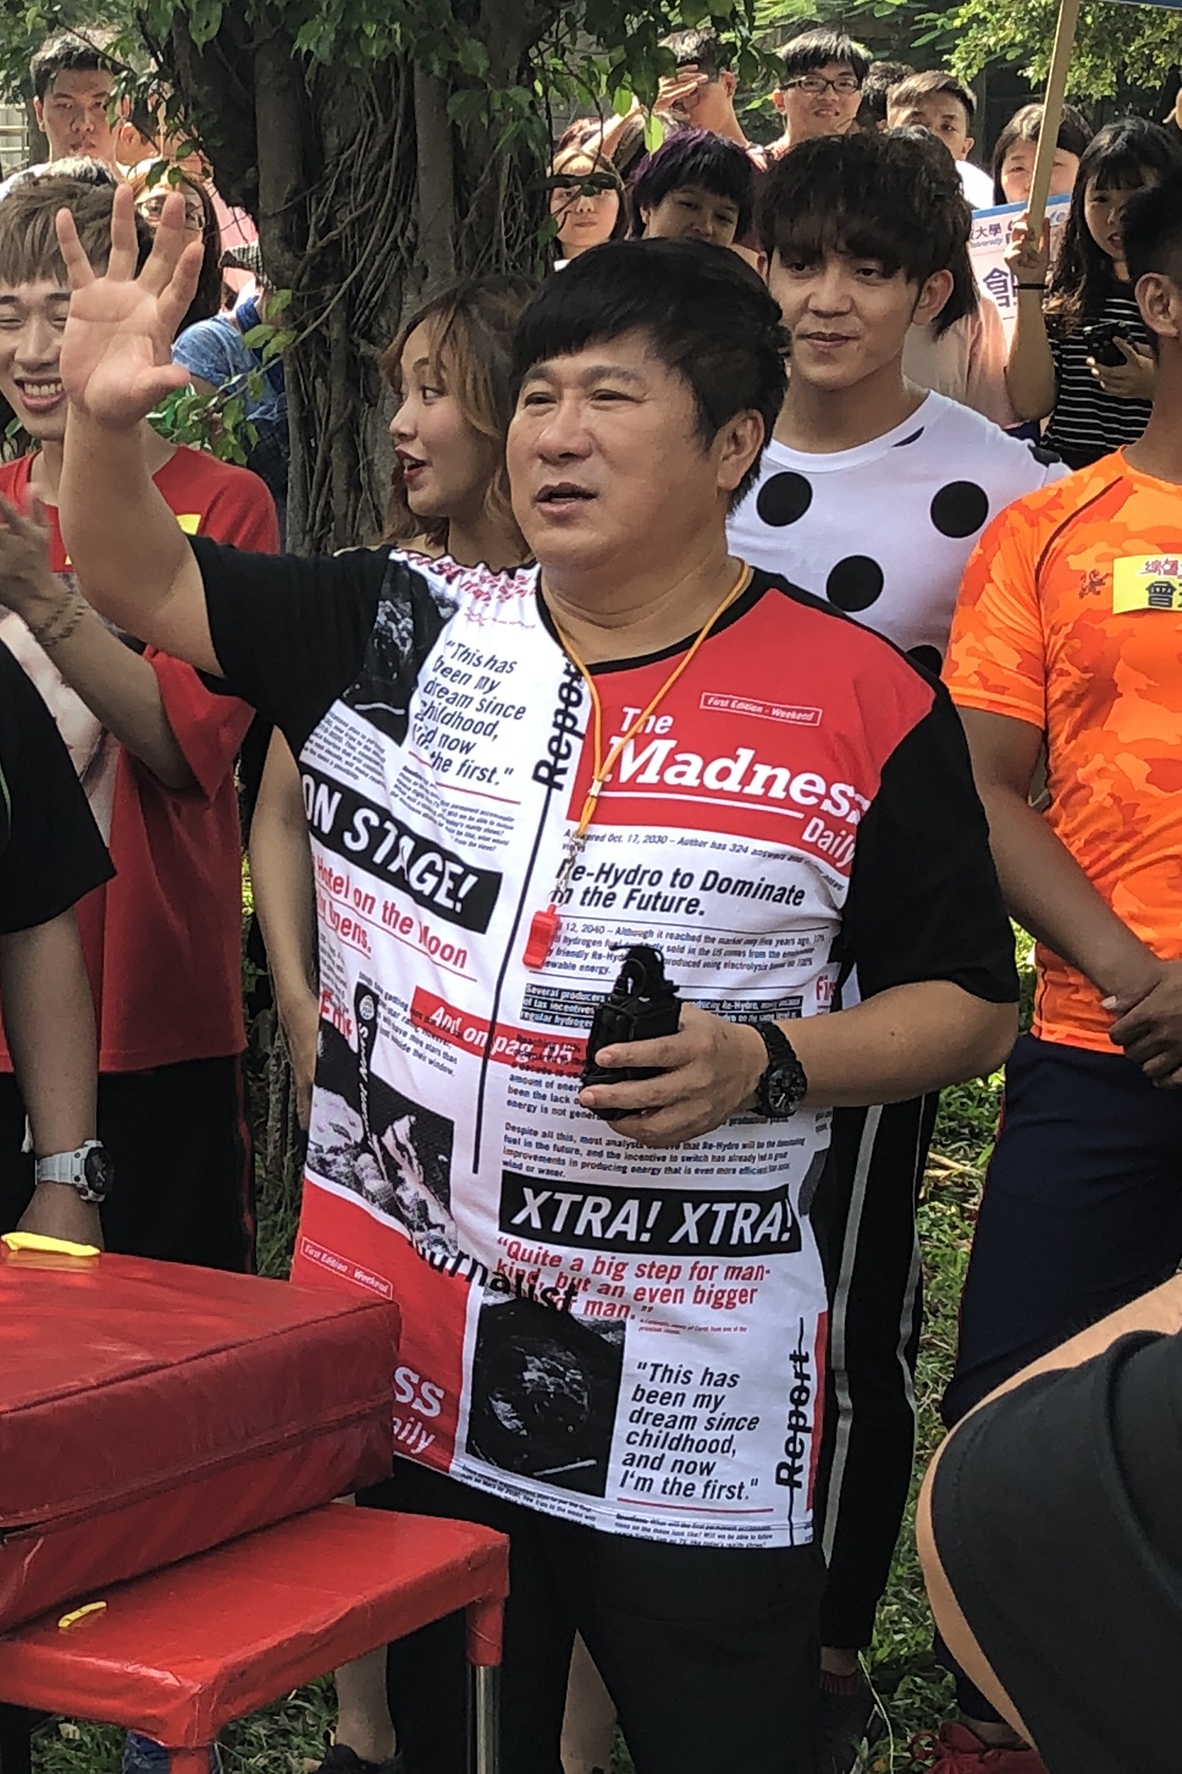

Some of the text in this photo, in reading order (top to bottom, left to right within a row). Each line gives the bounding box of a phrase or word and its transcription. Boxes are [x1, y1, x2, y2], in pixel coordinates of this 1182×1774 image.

[432, 655, 473, 686] been
[483, 655, 517, 674] has
[423, 677, 527, 721] dream since
[531, 651, 586, 792] Repor
[771, 707, 815, 721] Weekend
[437, 732, 478, 755] now
[643, 835, 668, 844] 2030
[729, 844, 750, 854] 324
[802, 817, 856, 869] Daily
[343, 808, 479, 913] STAGE!
[669, 868, 694, 889] to
[699, 870, 806, 906] Dominate
[353, 888, 376, 915] on
[381, 897, 414, 935] the
[579, 886, 617, 908] the
[623, 888, 706, 917] Future.
[581, 924, 605, 934] 2040
[526, 984, 559, 997] Several
[463, 1029, 489, 1048] on
[507, 1085, 570, 1104] been the lack
[545, 1079, 554, 1088] of
[506, 1099, 566, 1116] energy is not
[504, 1135, 521, 1145] fuel
[524, 1138, 532, 1147] in
[536, 1141, 550, 1151] the
[553, 1143, 583, 1157] future,
[586, 1149, 604, 1158] and
[606, 1150, 621, 1160] the
[624, 1150, 667, 1163] incentive
[681, 1153, 709, 1163] switch
[711, 1153, 725, 1162] has
[505, 1122, 539, 1137] Despite
[542, 1128, 554, 1139] all
[556, 1131, 577, 1144] this,
[580, 1135, 603, 1147] most
[742, 1140, 755, 1149] will
[502, 1158, 523, 1171] wind
[525, 1165, 535, 1173] or
[503, 1146, 566, 1167] improvements
[569, 1158, 578, 1167] in
[581, 1161, 628, 1174] producing
[631, 1165, 662, 1175] energy
[684, 1166, 692, 1175] is
[510, 1186, 794, 1246] XTRA! XTRA!
[496, 1236, 771, 1283] “Quite a big step for man-
[555, 1271, 591, 1292] but
[596, 1282, 625, 1299] an
[633, 1286, 686, 1304] even
[692, 1285, 759, 1310] bigger
[637, 1361, 740, 1389] "This has
[631, 1384, 726, 1414] been my
[629, 1407, 760, 1432] dream since
[775, 1349, 812, 1489] Report
[625, 1428, 737, 1458] childhood,
[622, 1451, 717, 1477] and now
[661, 1477, 696, 1498] the
[702, 1478, 759, 1501] first."
